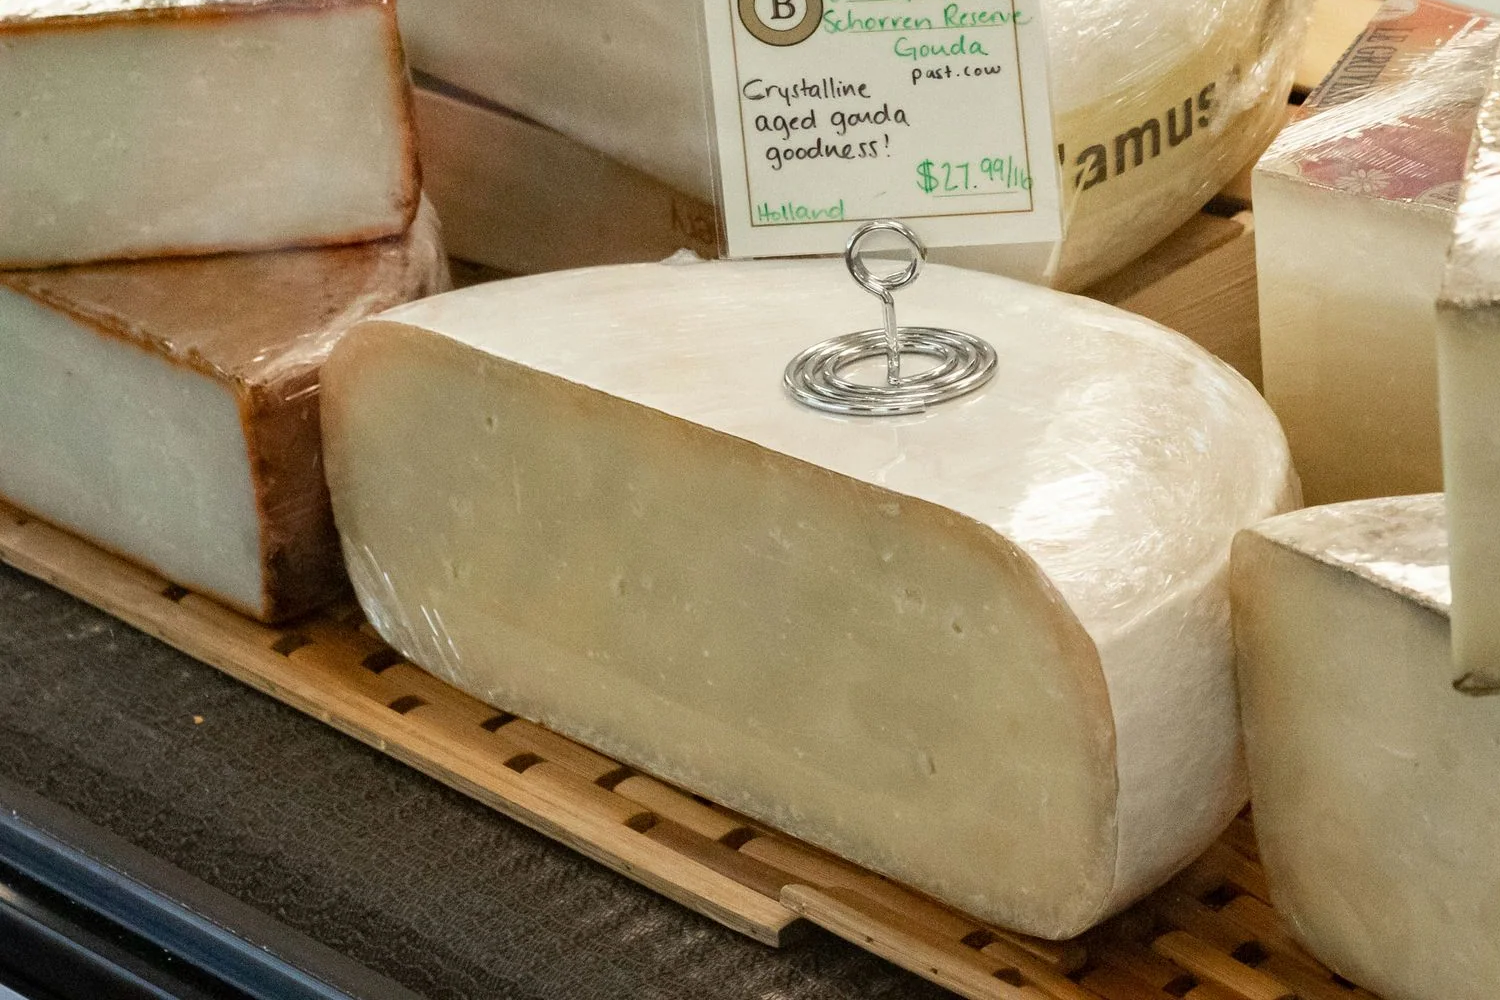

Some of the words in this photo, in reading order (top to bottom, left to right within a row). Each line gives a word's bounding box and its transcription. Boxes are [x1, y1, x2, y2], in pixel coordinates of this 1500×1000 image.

[822, 8, 933, 34] Schorren
[943, 3, 1033, 28] Reserve
[894, 34, 989, 61] Gouda
[742, 77, 872, 106] Crystalline
[755, 109, 817, 141] aged
[830, 103, 911, 136] gouda
[765, 134, 891, 171] goodness!
[756, 198, 845, 222] Holland
